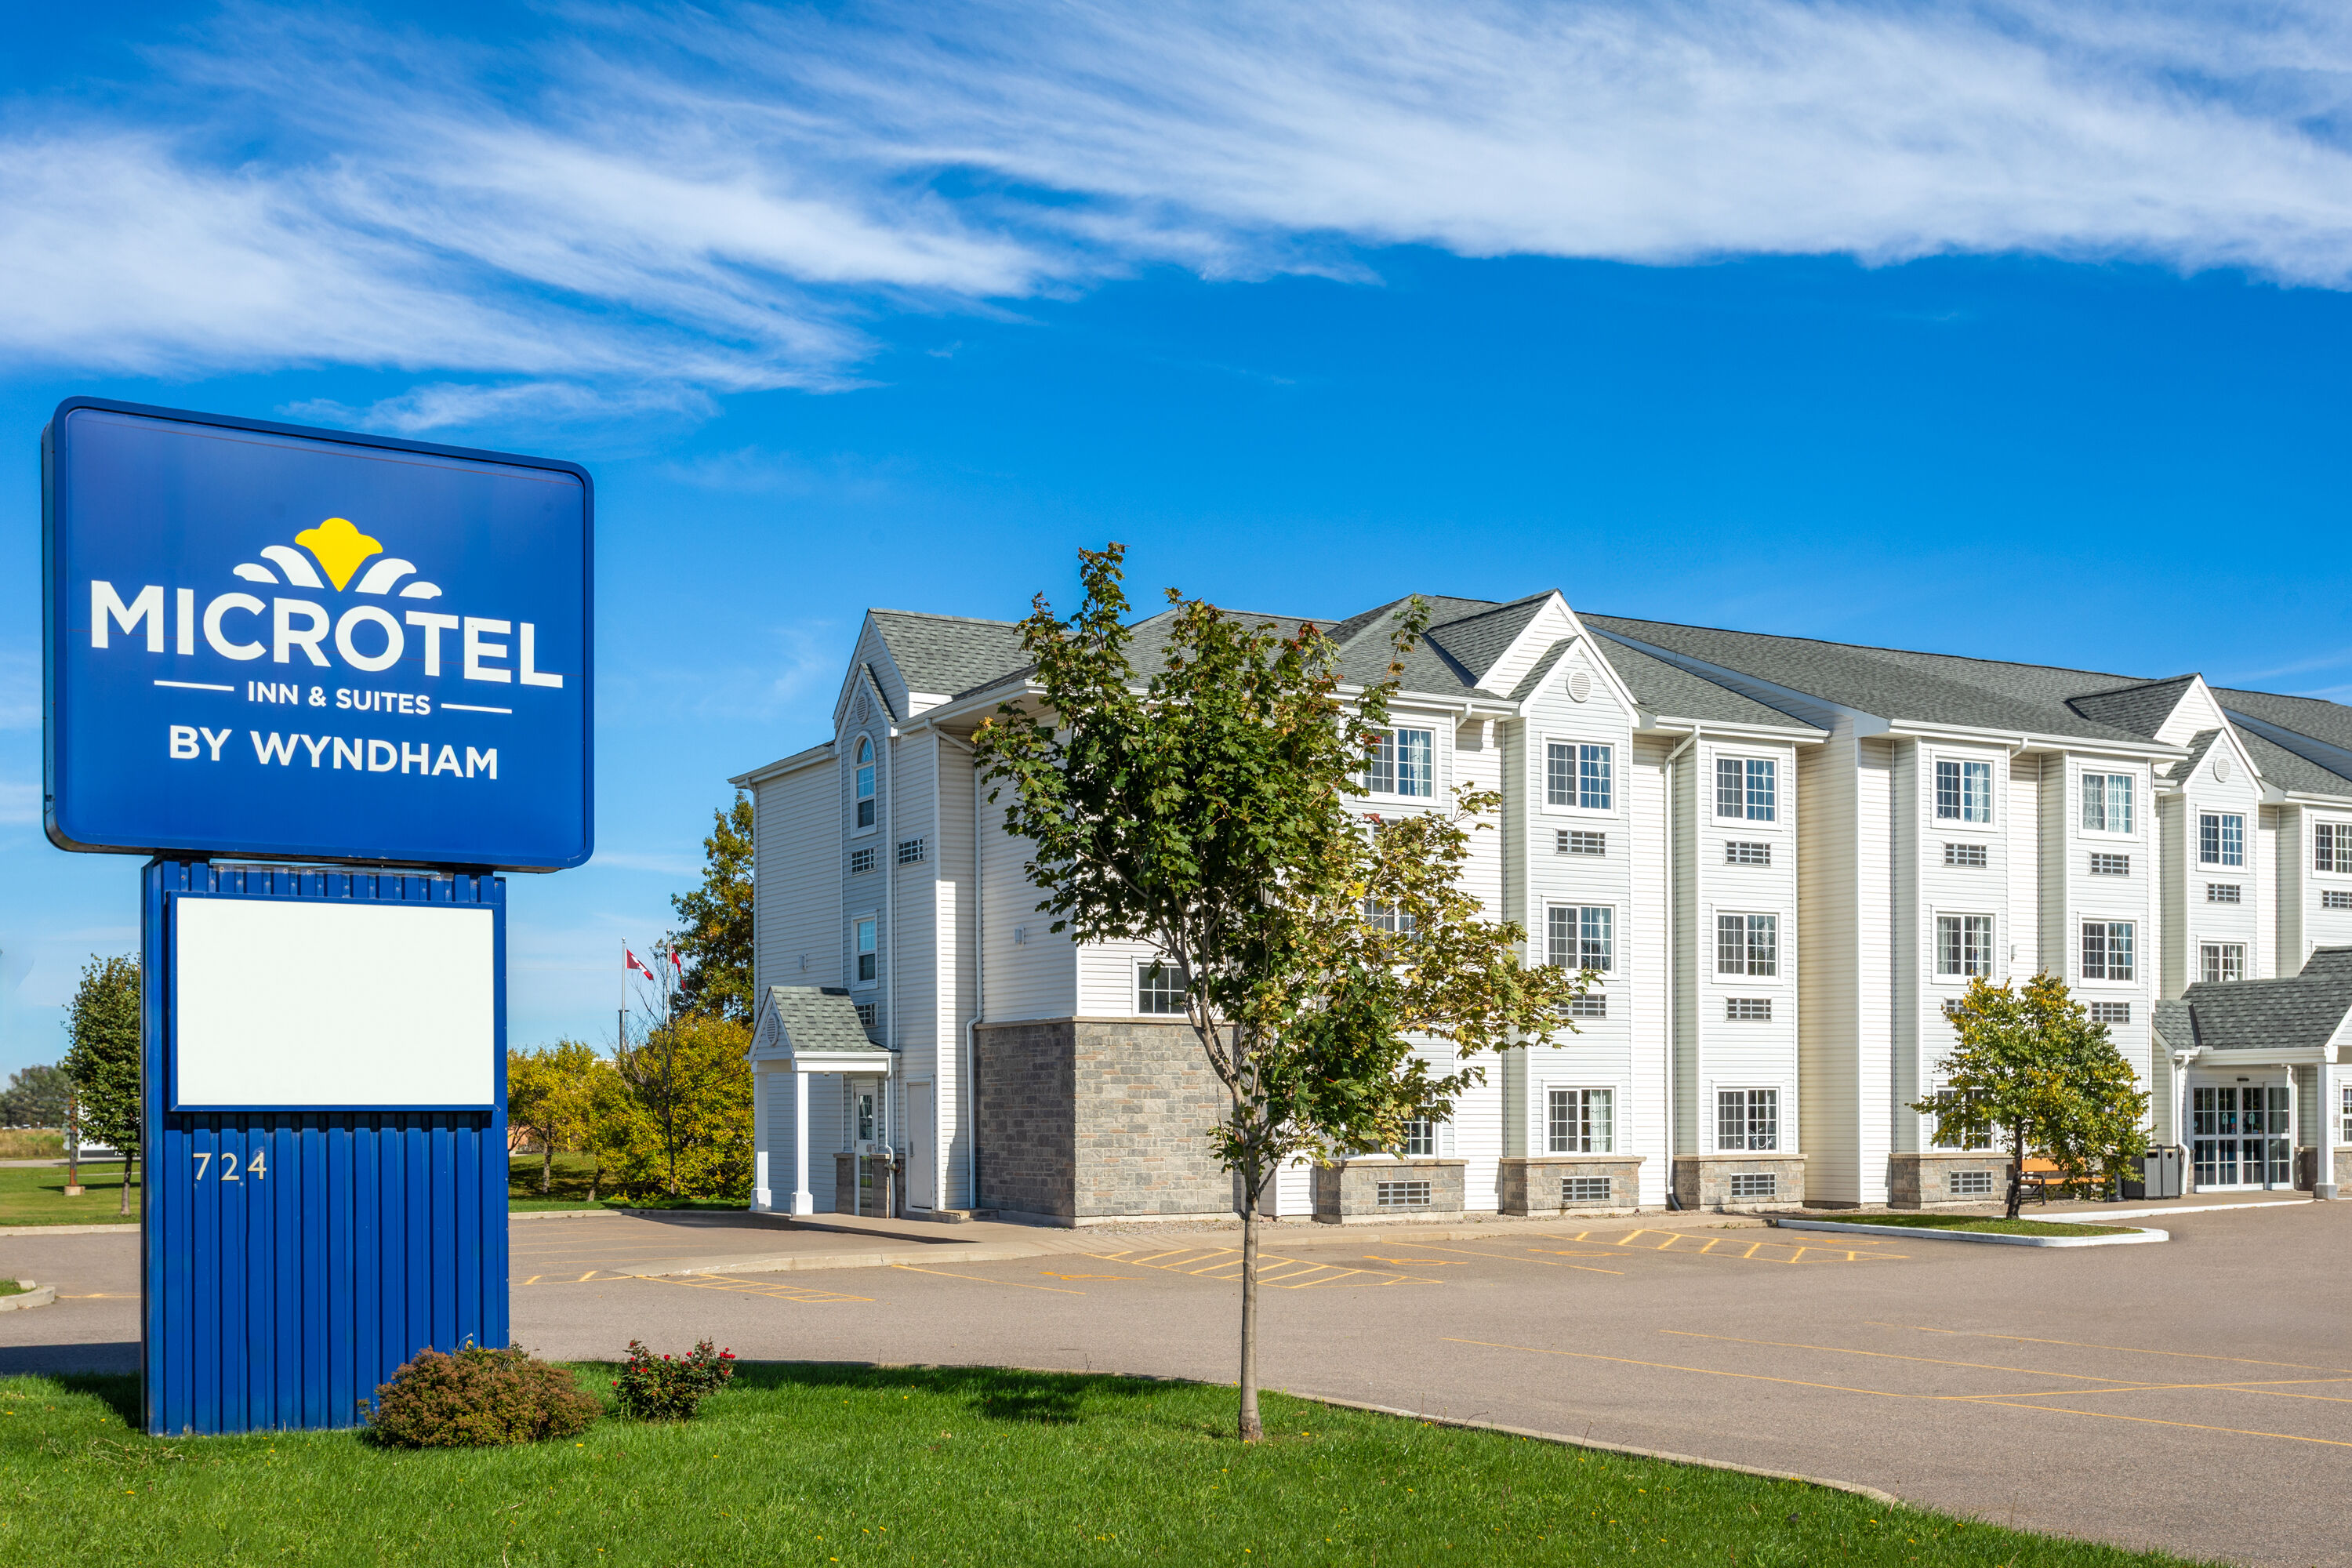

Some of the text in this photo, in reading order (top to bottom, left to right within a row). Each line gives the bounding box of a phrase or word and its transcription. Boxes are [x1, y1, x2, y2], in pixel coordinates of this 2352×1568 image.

[91, 579, 563, 688] MICROTEL
[248, 681, 431, 716] INN & SUITES
[169, 724, 497, 780] BY WYNDHAM
[193, 1151, 267, 1181] 724
